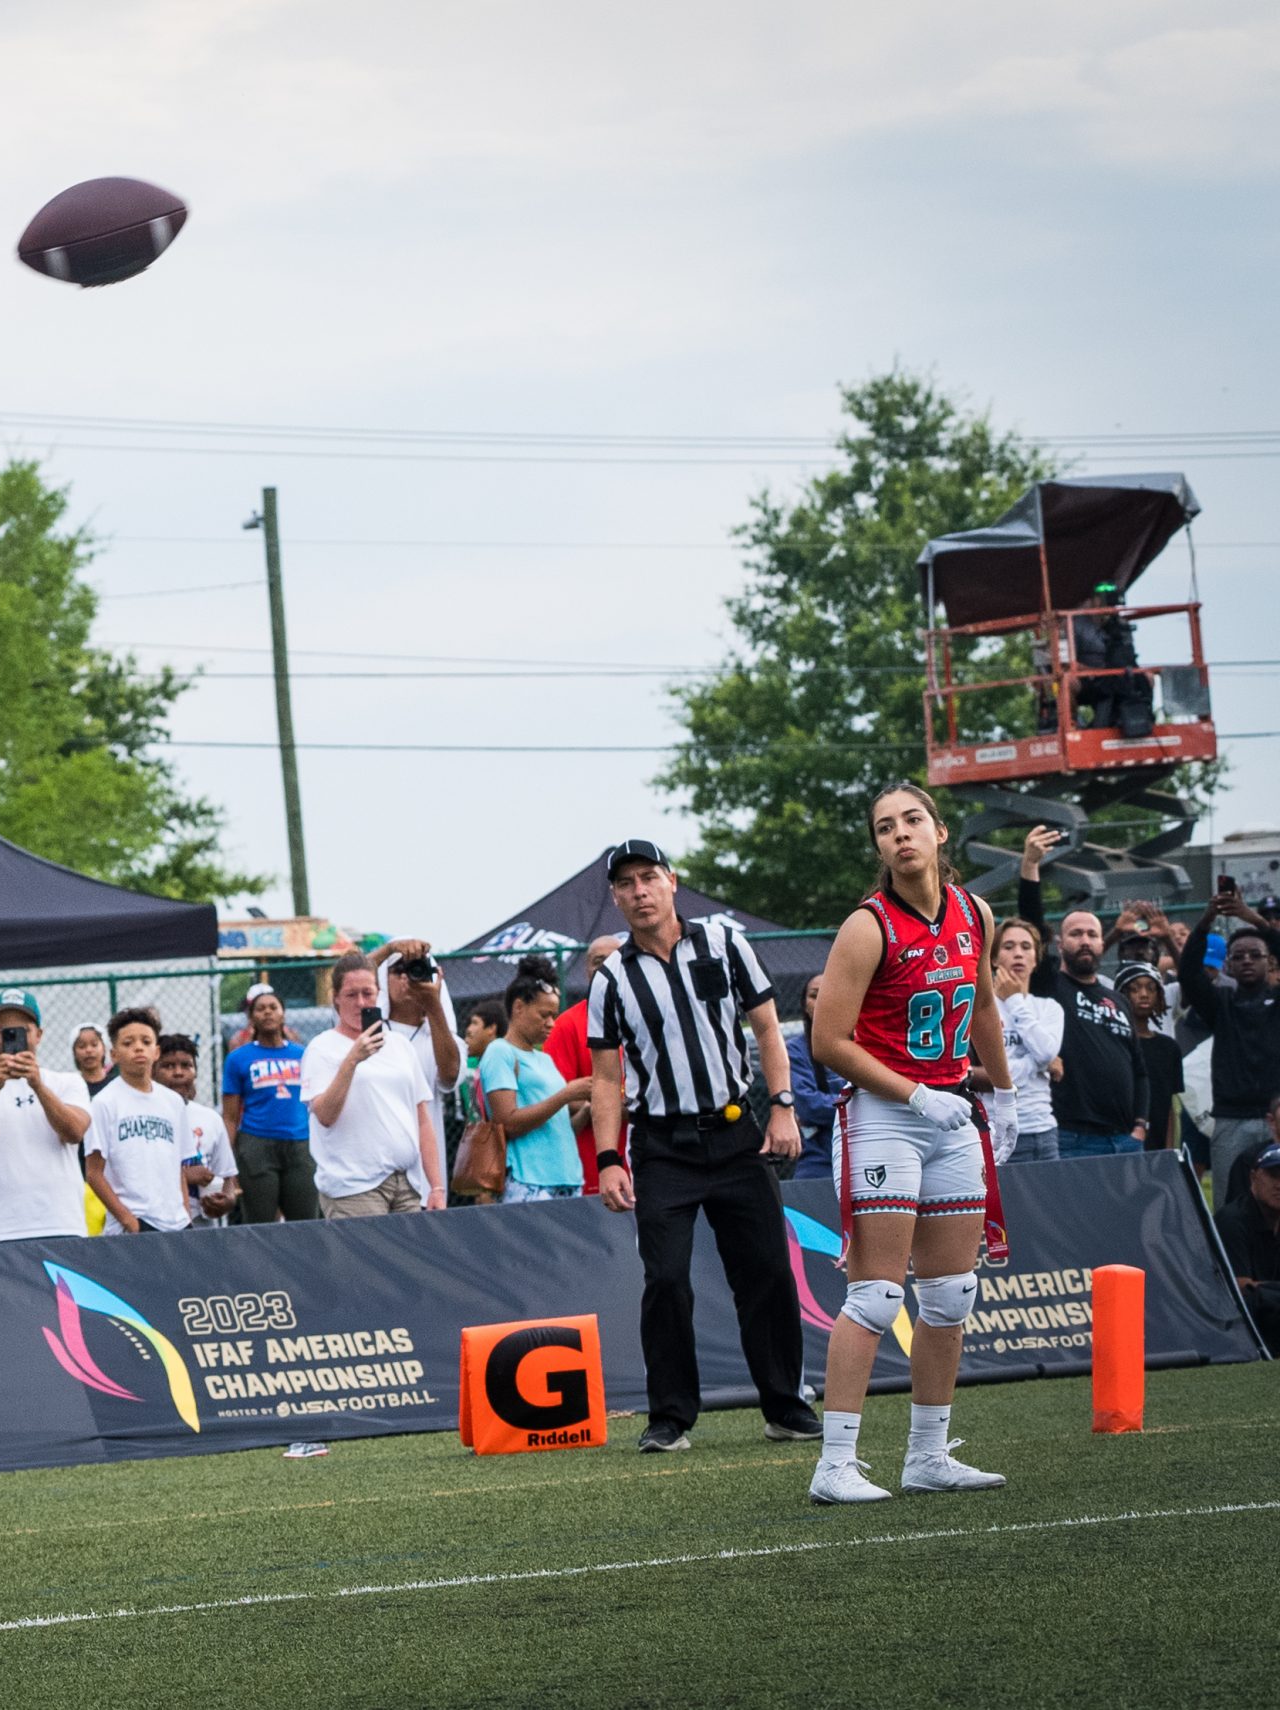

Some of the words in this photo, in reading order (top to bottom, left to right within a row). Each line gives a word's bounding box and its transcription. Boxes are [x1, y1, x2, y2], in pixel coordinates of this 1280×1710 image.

[907, 983, 977, 1060] 82
[178, 1290, 297, 1336] 2023
[192, 1340, 254, 1369] IFAF
[265, 1327, 415, 1364] AMERICAS
[204, 1359, 425, 1400] CHAMPIONSHIP
[485, 1326, 591, 1431] G
[527, 1429, 591, 1447] Riddell
